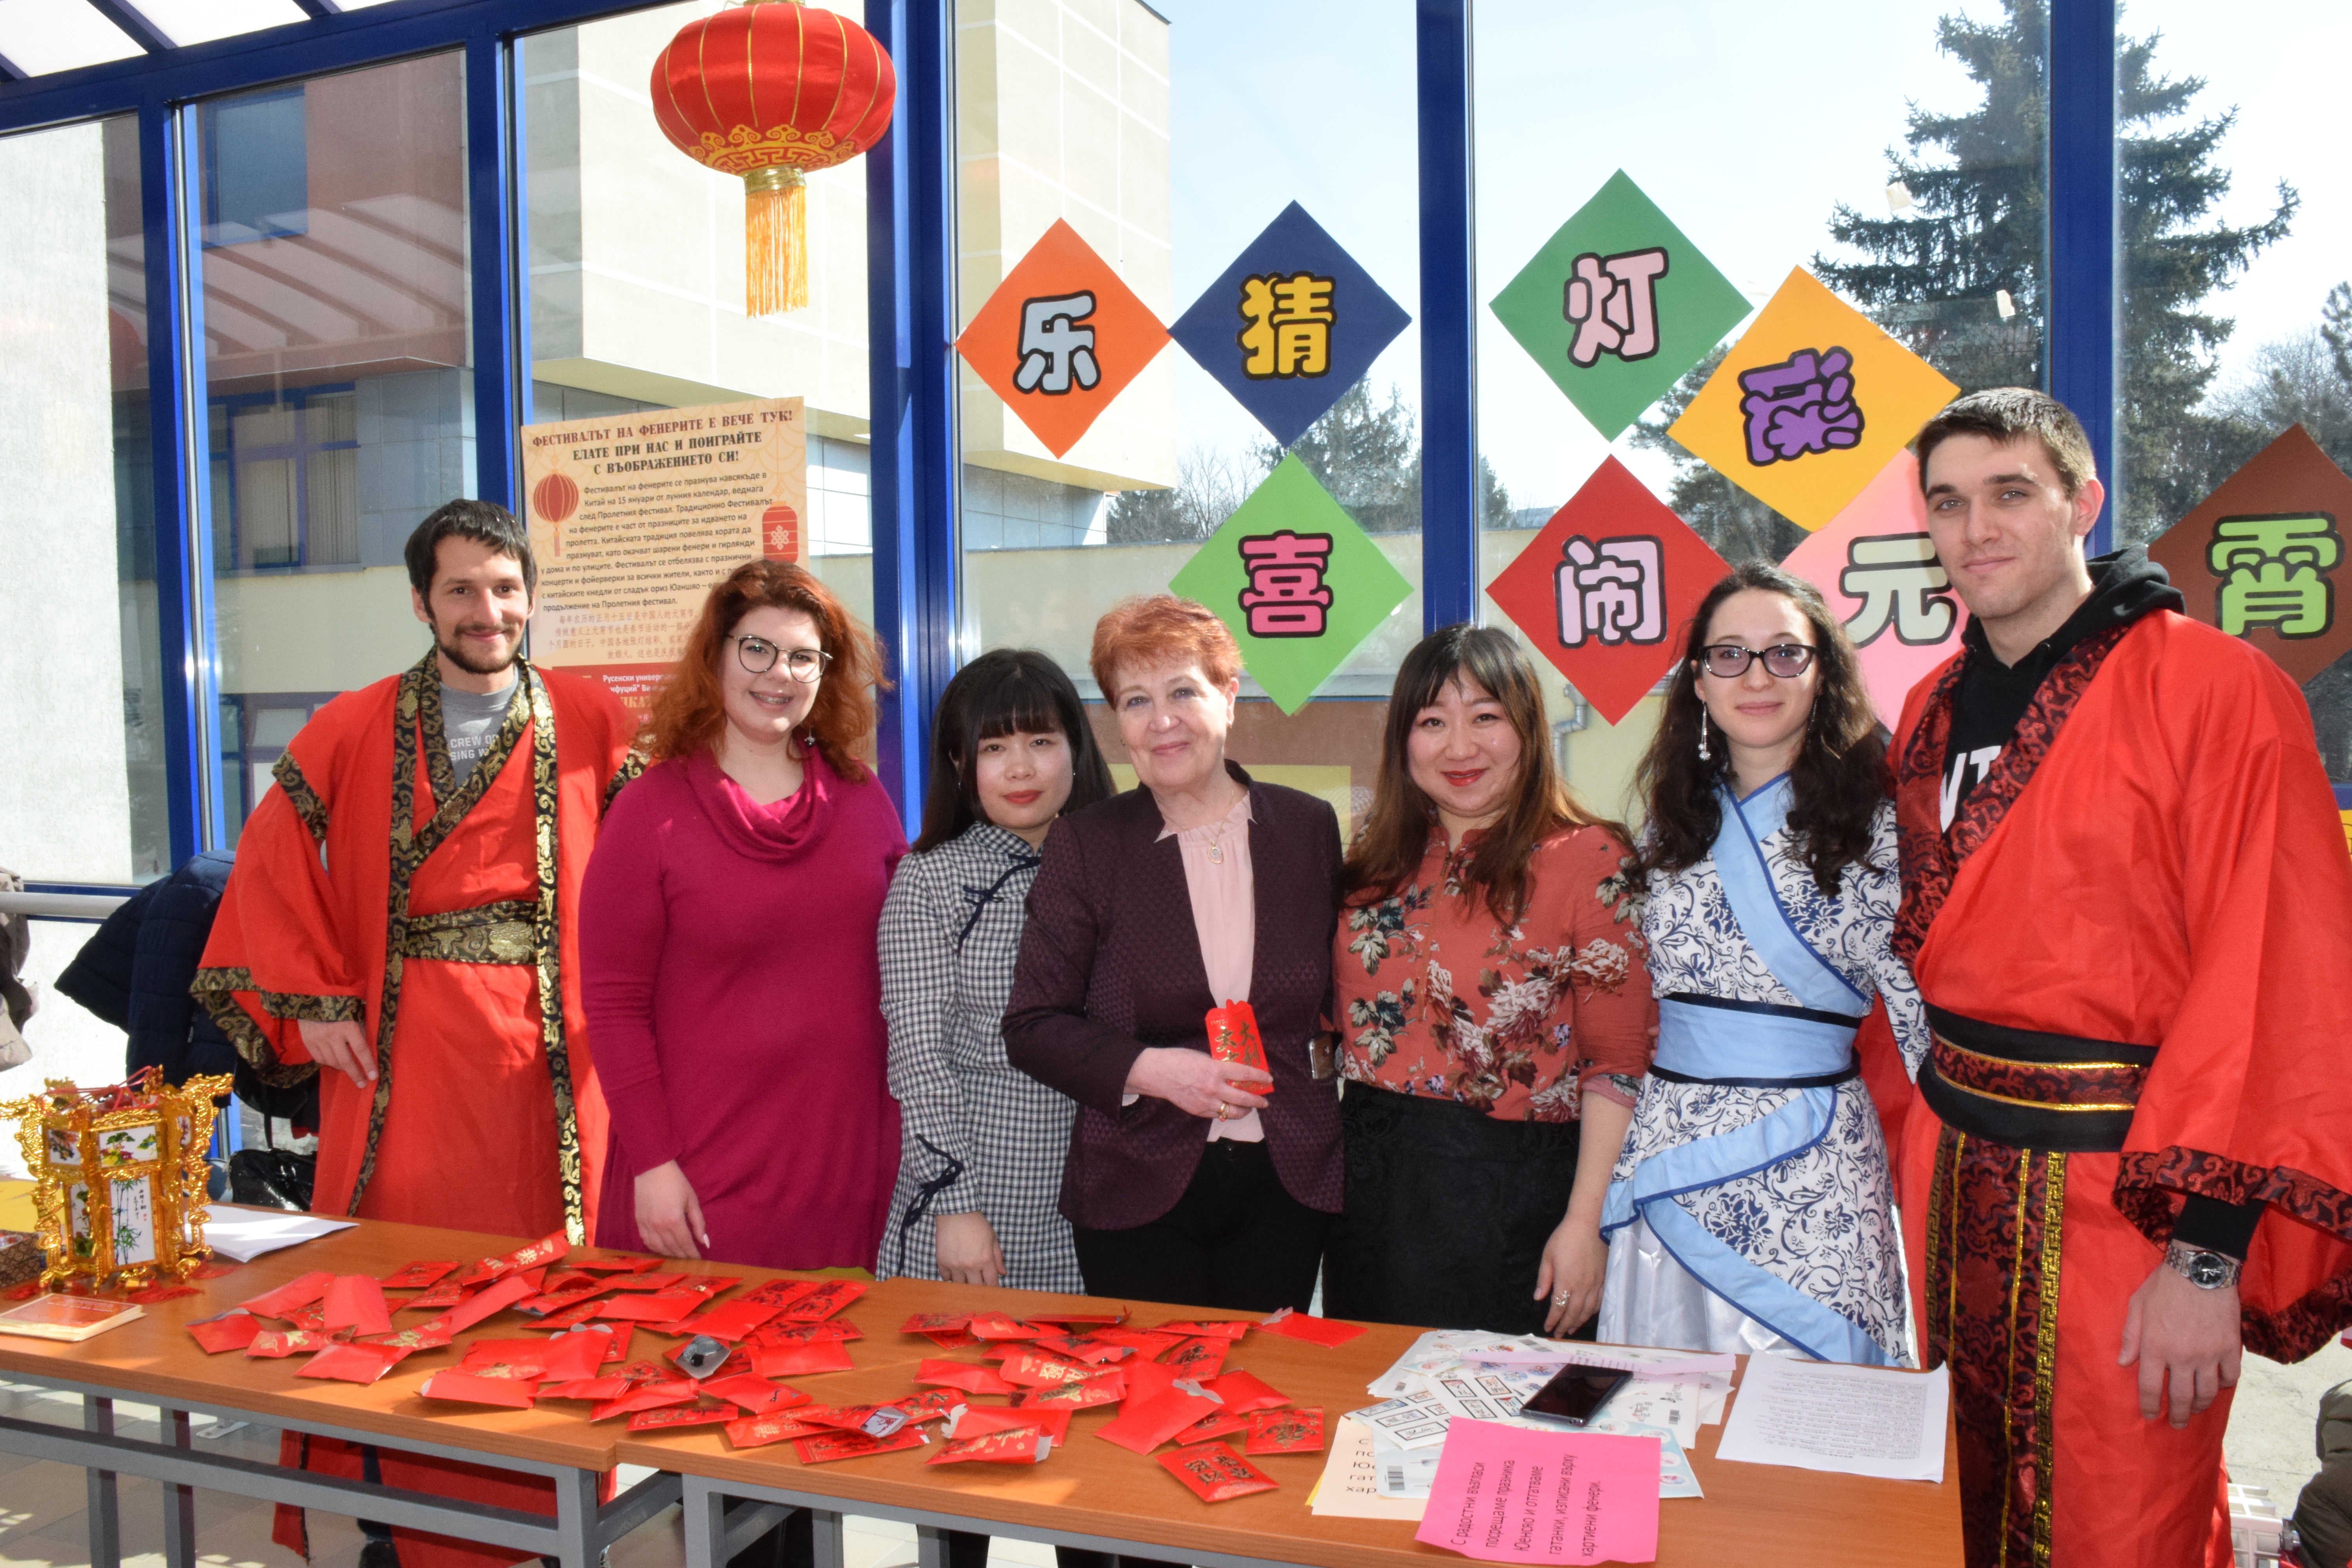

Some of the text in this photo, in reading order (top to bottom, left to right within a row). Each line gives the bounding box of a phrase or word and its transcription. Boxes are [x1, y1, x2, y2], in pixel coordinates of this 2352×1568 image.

[1013, 290, 1101, 395] 乐
[1236, 270, 1336, 381] 猜
[1564, 247, 1668, 368] 灯
[533, 410, 793, 446] ФЕСТИВАЛЪТ НА ФЕНЕРИТЕ Е ВЕЧЕ ТУК!
[573, 430, 762, 461] ЕЛАТЕ ПРИ НАС И ПОИГРАЙТЕ
[594, 450, 739, 474] С ВЪОБРАЖЕНИЕТО СИ!
[638, 481, 673, 491] фенерите
[684, 477, 717, 486] празнува
[720, 473, 760, 482] навсякъде
[628, 496, 654, 504] януари
[666, 492, 691, 501] лунния
[693, 489, 730, 498] календар,
[733, 486, 763, 495] веднага
[598, 510, 636, 520] Пролетния
[639, 506, 674, 517] фестивал.
[676, 502, 725, 513] Традиционно
[727, 499, 773, 507] Фестивалът
[579, 524, 613, 534] фенерите
[648, 518, 690, 528] празниците
[701, 515, 736, 523] идването
[566, 539, 599, 548] пролетта.
[601, 535, 641, 544] Китайската
[643, 533, 677, 542] традиция
[715, 527, 739, 536] хората
[566, 551, 604, 560] празнуват,
[653, 545, 680, 554] шарени
[682, 543, 710, 553] фенери
[719, 540, 755, 549] гирлянди
[546, 566, 564, 575] дома
[583, 563, 613, 572] улиците.
[615, 559, 656, 569] Фестивалът
[668, 557, 703, 565] отбелязва
[711, 554, 752, 563] празнични
[541, 578, 573, 587] концерти
[581, 575, 625, 584] фойерверки
[1238, 529, 1333, 639] 喜
[1553, 534, 1667, 650] 闹
[1840, 532, 1958, 649] 元
[547, 590, 584, 599] китайските
[651, 585, 668, 593] ориз
[543, 602, 590, 612] продължение
[602, 600, 641, 609] Пролетния
[642, 598, 677, 607] фестивал.
[603, 674, 634, 684] Русенски
[450, 736, 481, 748] CREW
[1456, 1497, 1477, 1538] радостни
[1467, 1462, 1485, 1495] възгласи
[1486, 1459, 1515, 1548] посрещаме празника
[1514, 1517, 1535, 1552] Юенсяо
[1526, 1465, 1544, 1507] отгатваме
[1549, 1454, 1578, 1555] гатанки, изписани върху
[1581, 1481, 1603, 1557] хартиени фенери.
